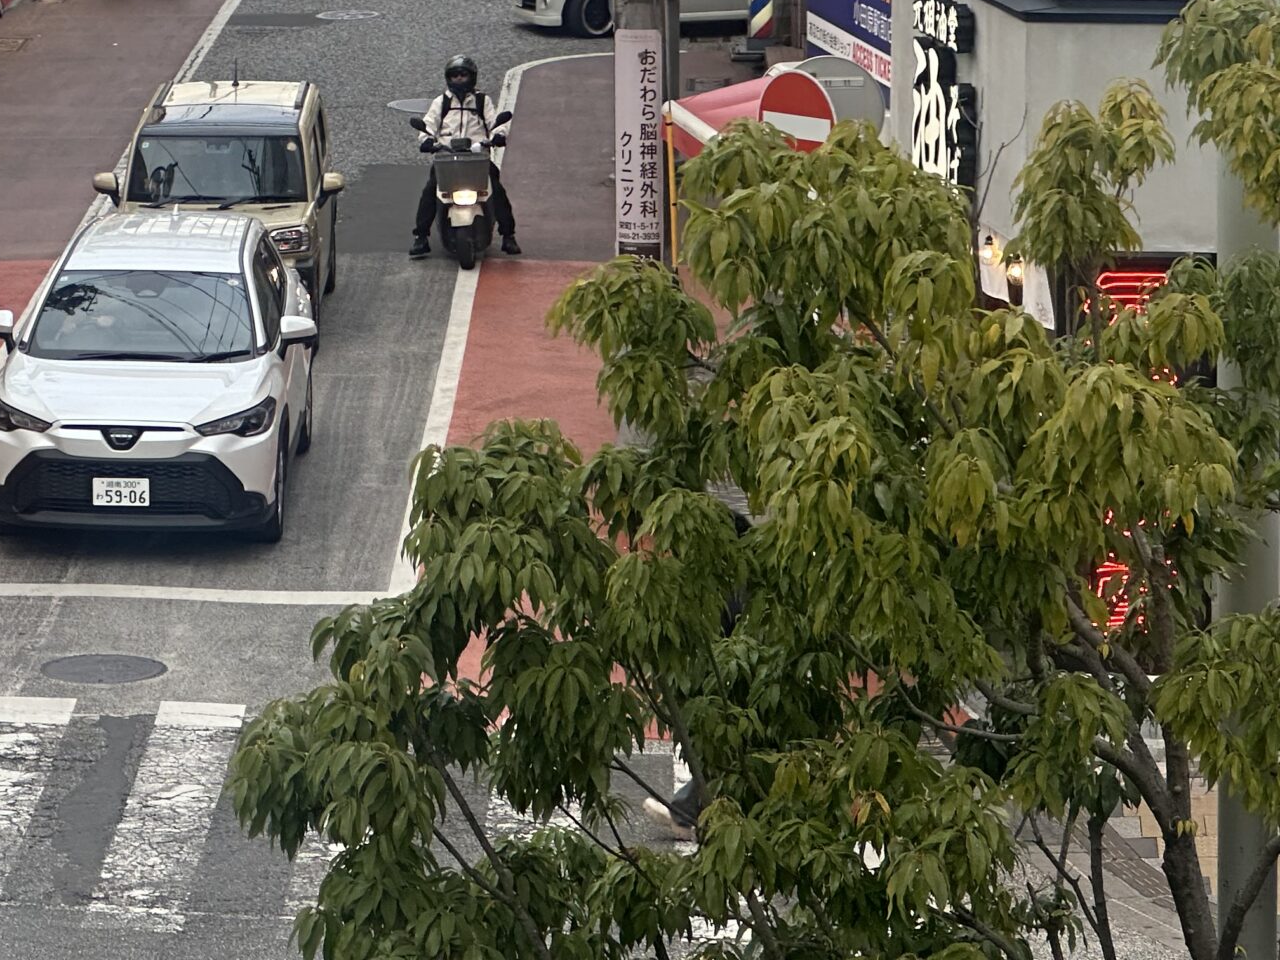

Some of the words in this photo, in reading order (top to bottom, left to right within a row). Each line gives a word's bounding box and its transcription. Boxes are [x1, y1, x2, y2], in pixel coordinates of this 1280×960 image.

[640, 49, 658, 218] おだわら脳神経外科
[620, 131, 634, 216] クリニック
[105, 489, 145, 503] 59-06
[123, 480, 136, 488] 300
